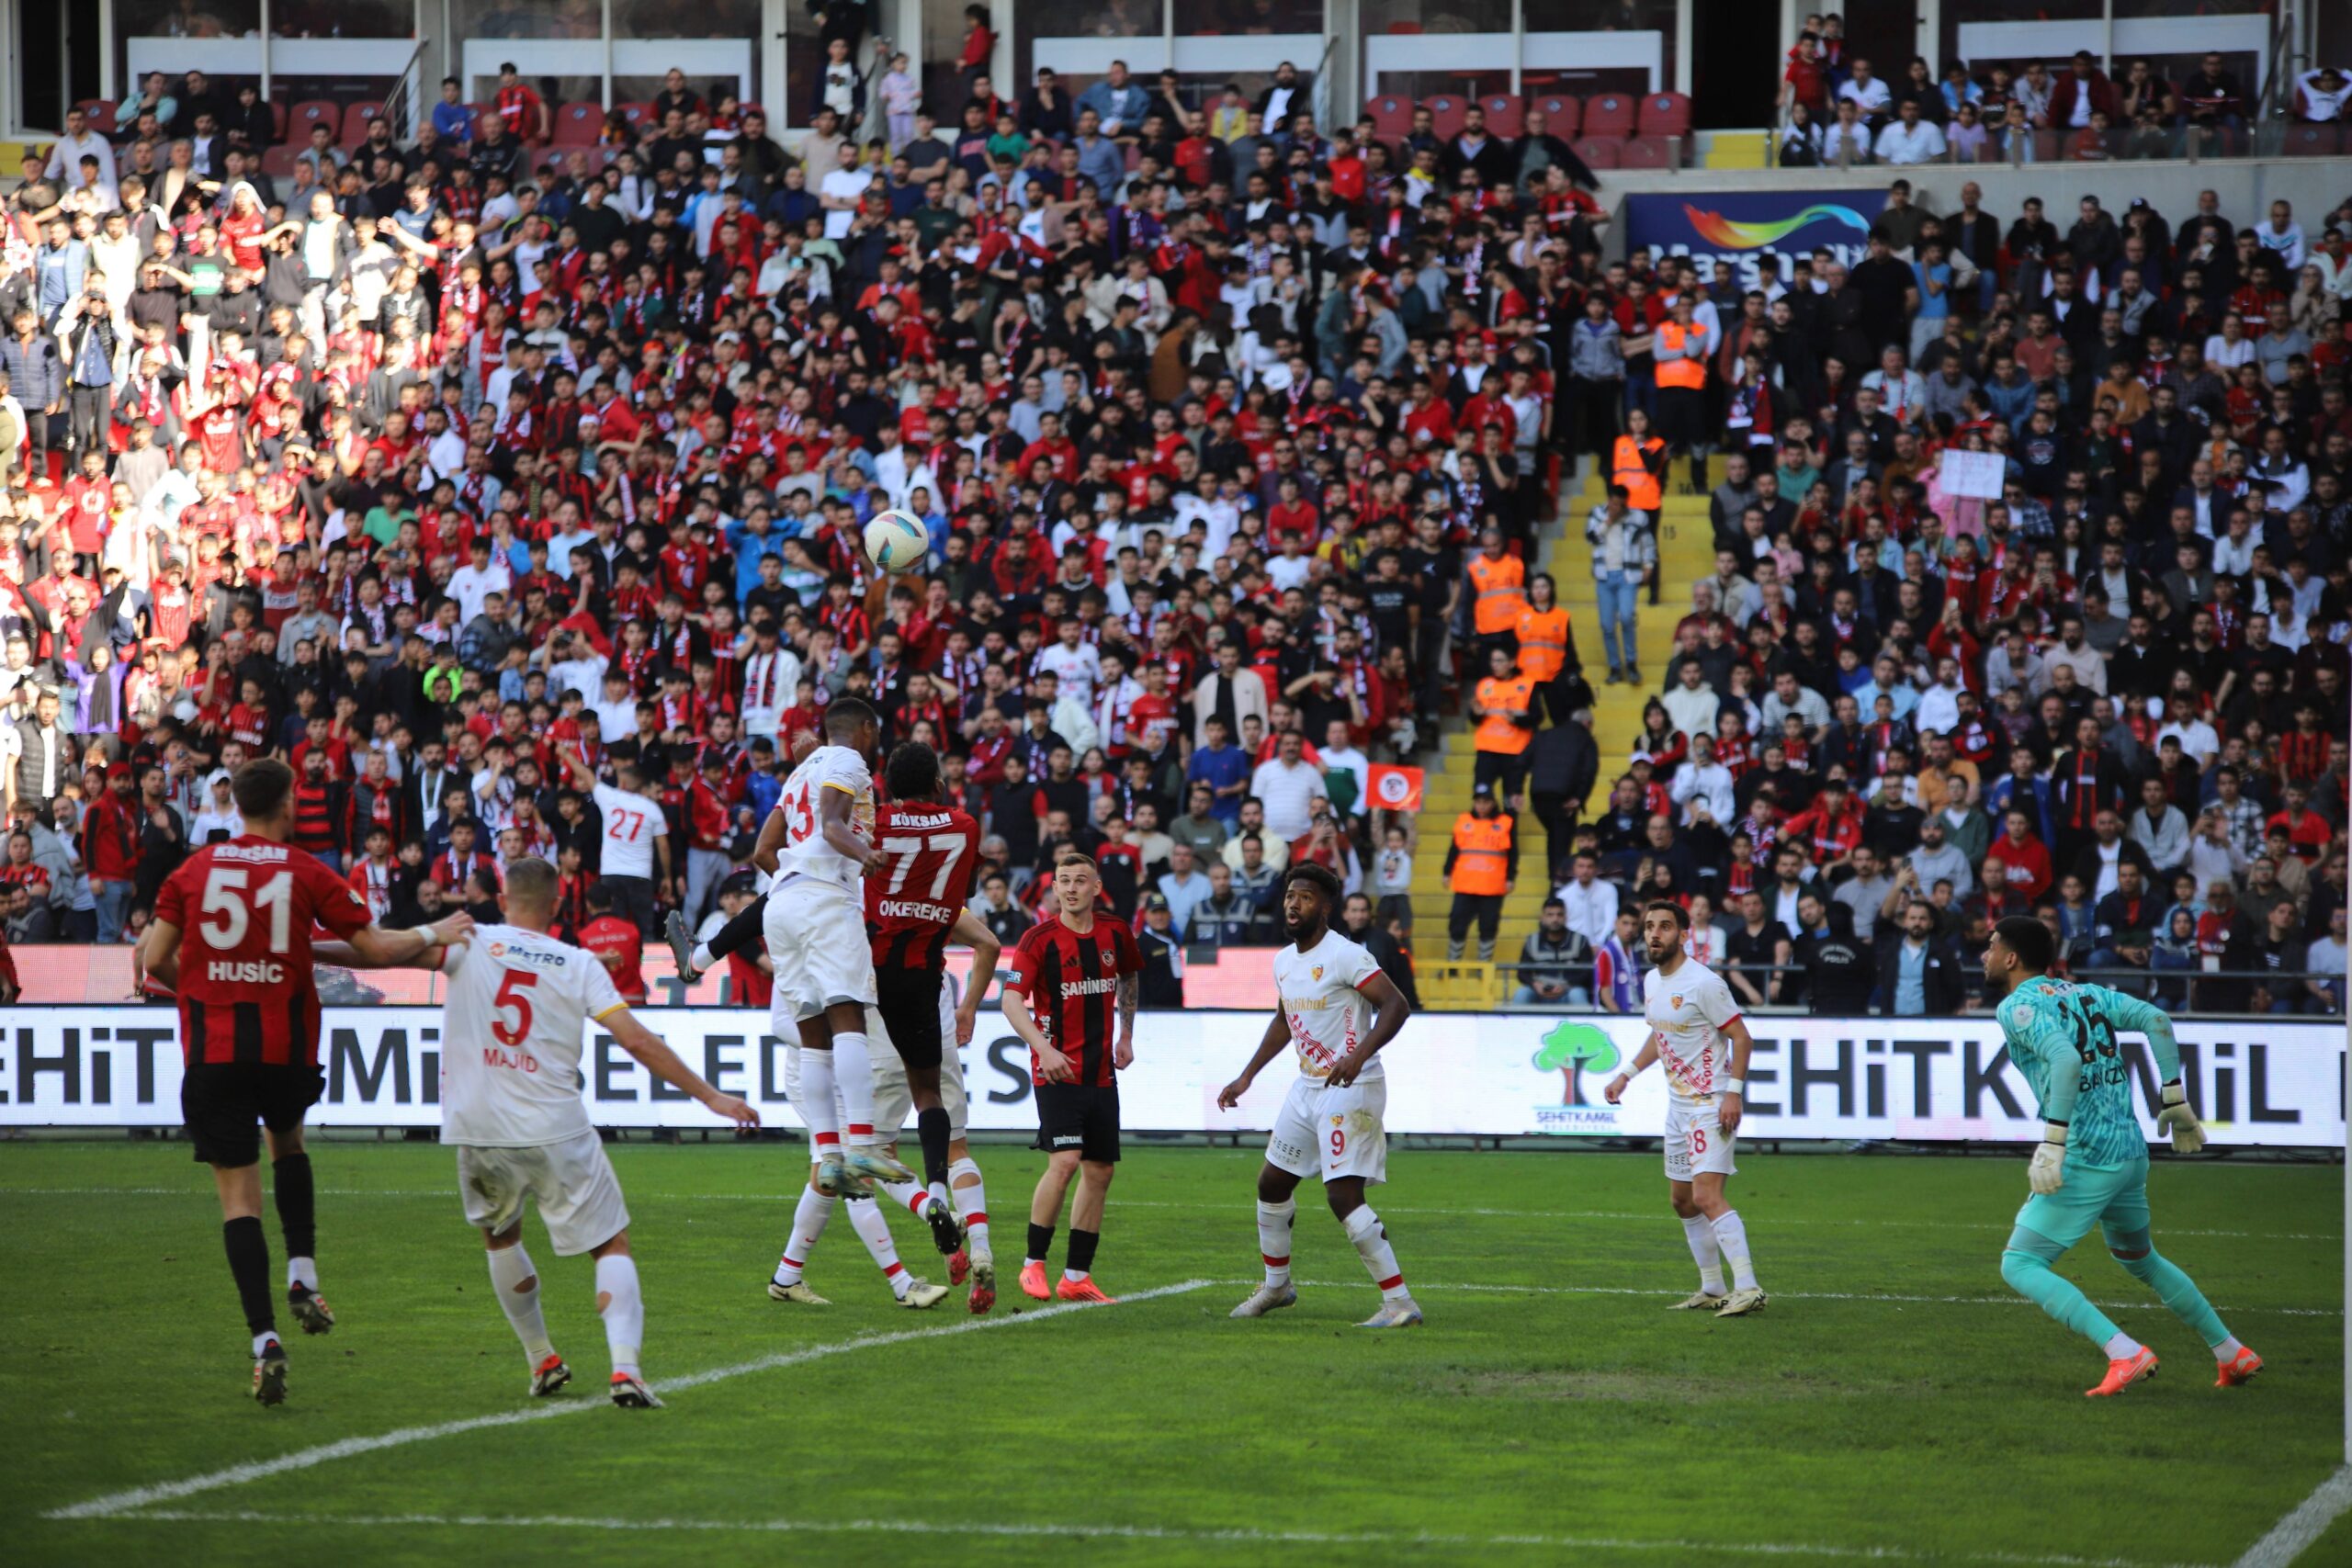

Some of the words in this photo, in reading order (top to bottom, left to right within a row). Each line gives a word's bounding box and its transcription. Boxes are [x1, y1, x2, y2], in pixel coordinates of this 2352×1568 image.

[609, 807, 645, 842] 27
[890, 811, 953, 828] KÖKSAN
[881, 833, 967, 900] 77
[199, 868, 294, 954] 51
[879, 899, 952, 924] OKEREKE
[492, 968, 539, 1047] 5
[2057, 995, 2117, 1066] 25
[483, 1048, 539, 1073] MAJID
[1330, 1130, 1345, 1156] 9
